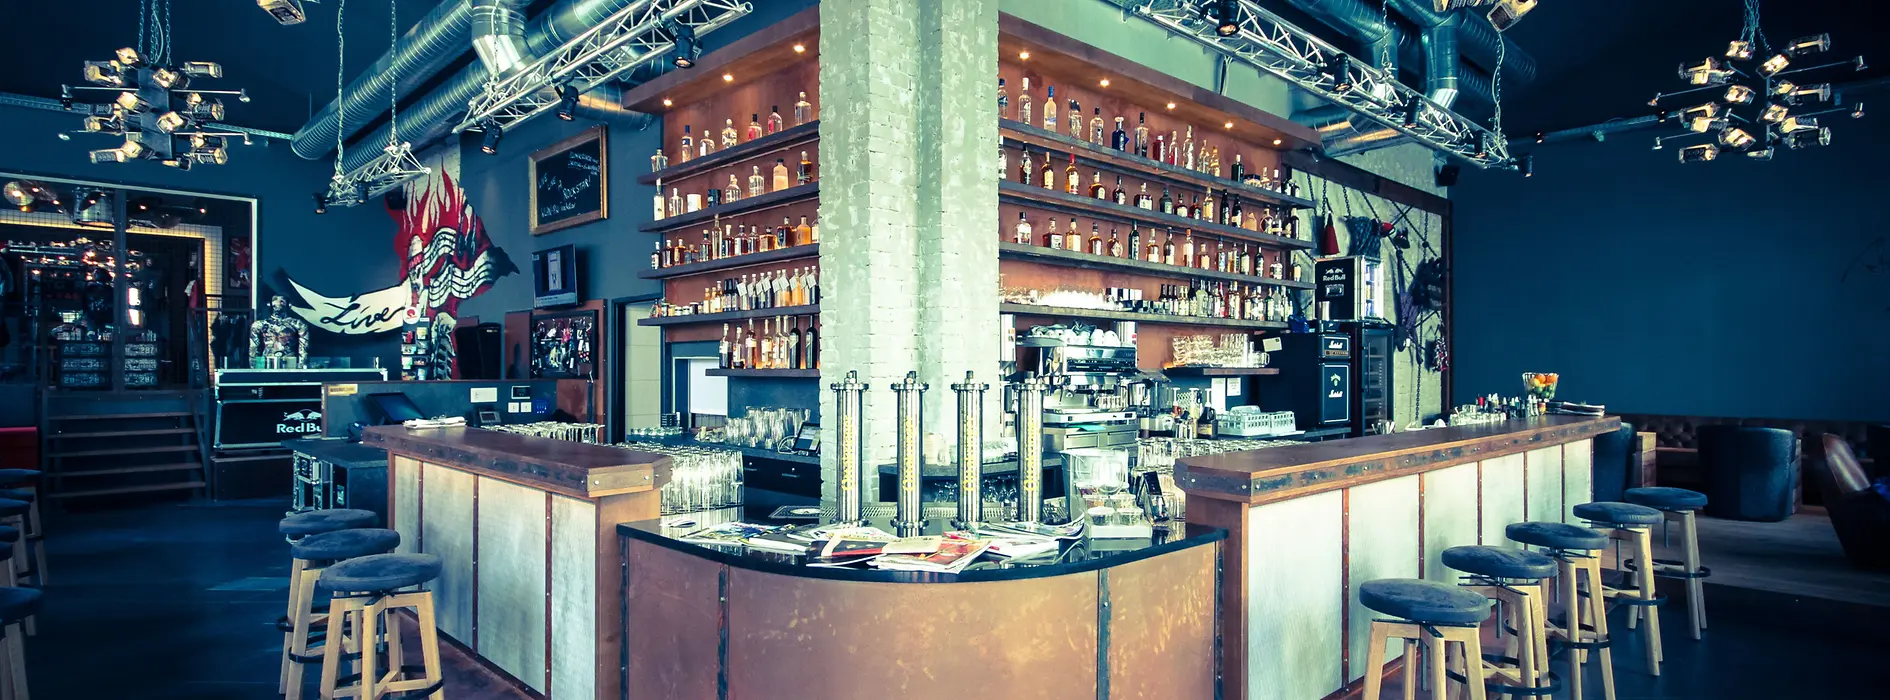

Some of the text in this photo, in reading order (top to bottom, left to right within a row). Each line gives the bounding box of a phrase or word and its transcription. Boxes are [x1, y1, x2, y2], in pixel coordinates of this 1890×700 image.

[320, 302, 405, 329] Live
[277, 422, 322, 433] Red Bu
